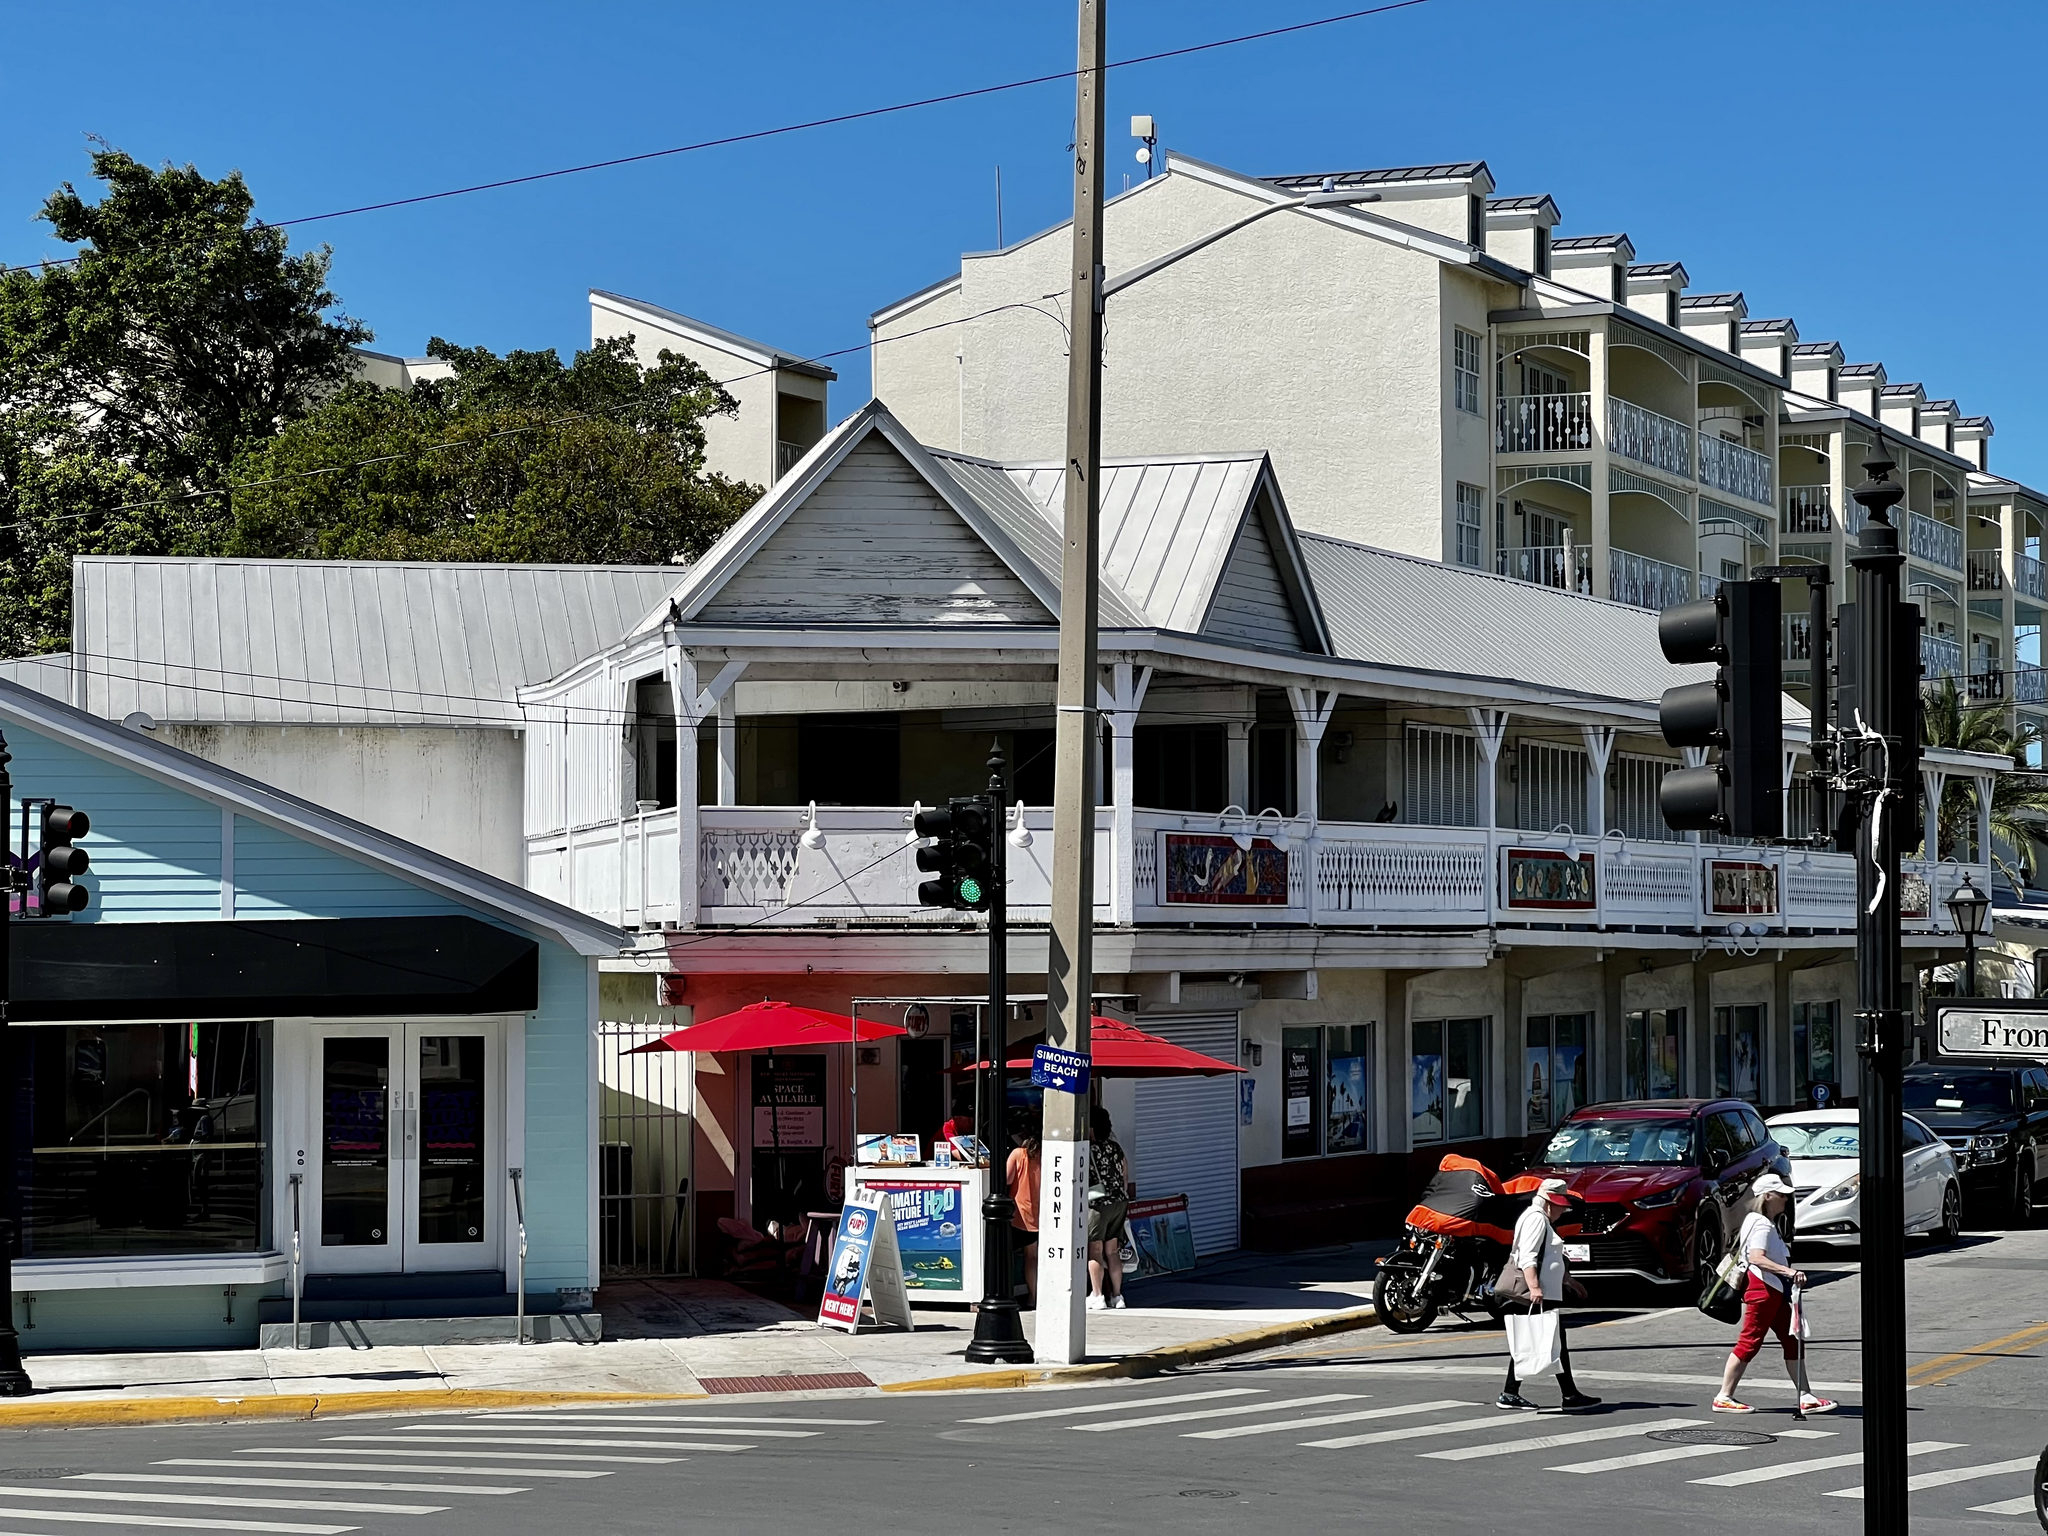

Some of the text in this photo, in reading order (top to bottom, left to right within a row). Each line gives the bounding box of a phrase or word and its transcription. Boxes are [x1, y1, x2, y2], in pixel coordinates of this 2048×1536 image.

[1036, 1049, 1089, 1068] SIMONTON
[1043, 1062, 1079, 1078] BEACH
[774, 1084, 804, 1093] SPACE
[330, 1091, 380, 1111] FAT
[427, 1090, 477, 1109] FAT
[760, 1095, 816, 1103] AVAILABLE
[334, 1112, 380, 1126] TUES
[429, 1109, 477, 1124] TUES
[331, 1127, 378, 1142] DAY
[426, 1125, 476, 1142] DAY
[891, 1189, 922, 1209] IMATE
[1048, 1155, 1065, 1259] FRONT ST
[892, 1205, 922, 1221] ENTURE
[848, 1217, 866, 1231] FURY
[1076, 1246, 1085, 1260] ST
[824, 1299, 855, 1318] RENT HERE
